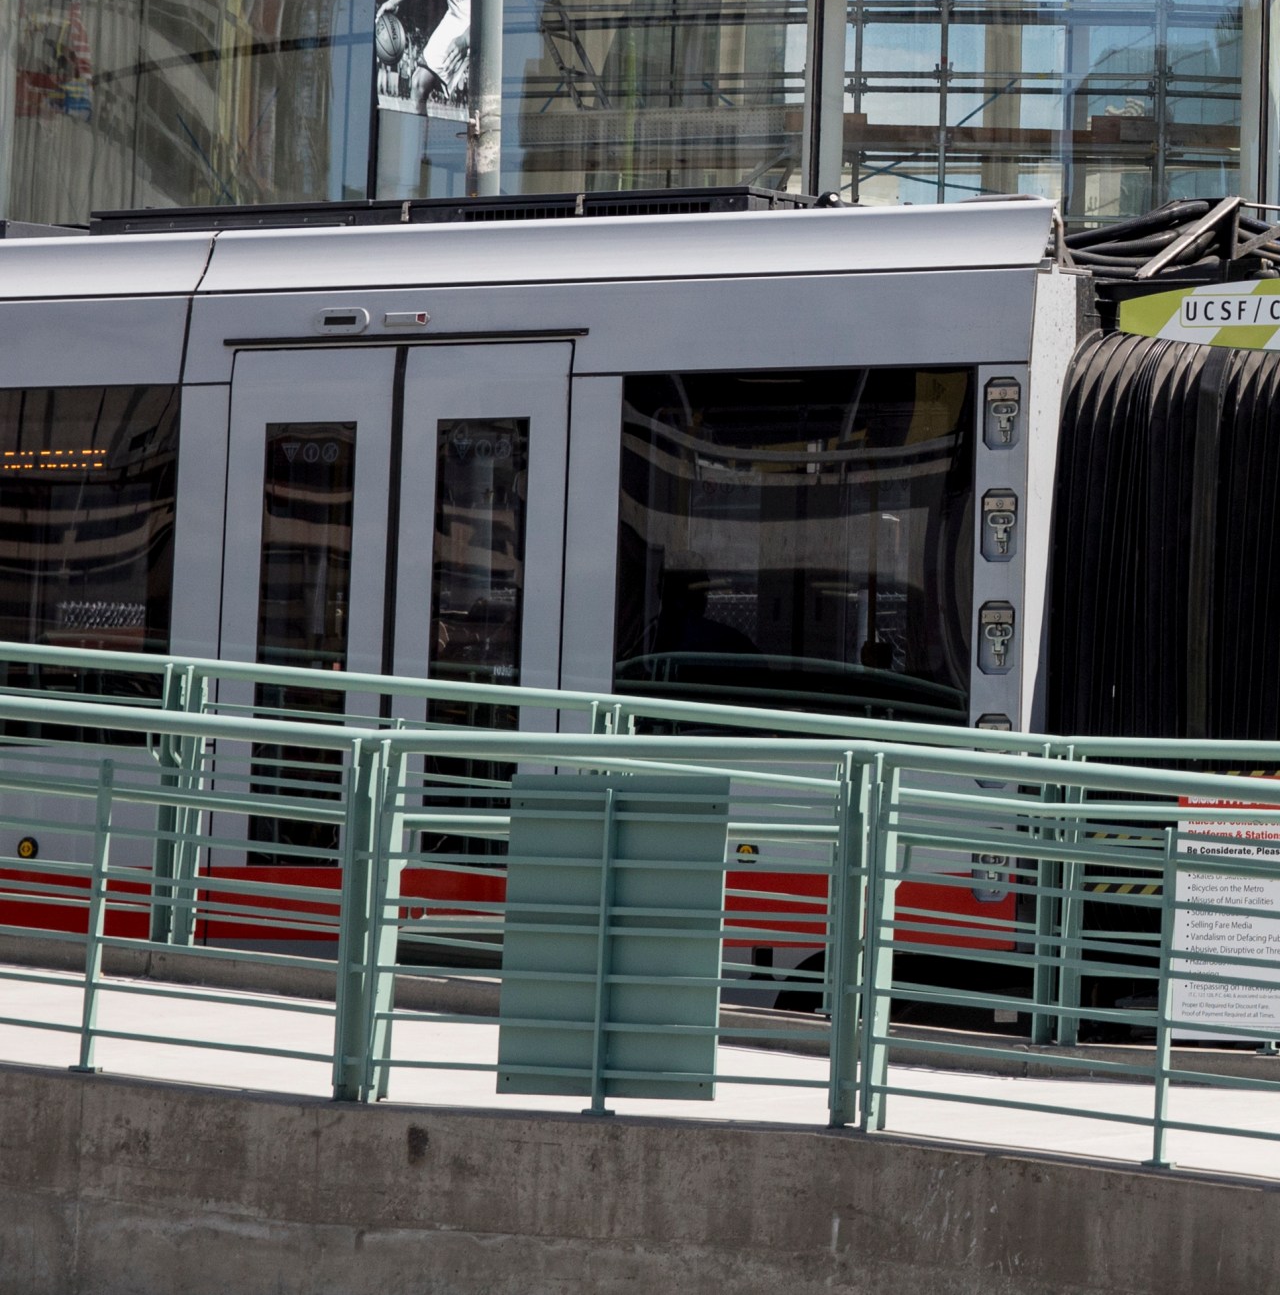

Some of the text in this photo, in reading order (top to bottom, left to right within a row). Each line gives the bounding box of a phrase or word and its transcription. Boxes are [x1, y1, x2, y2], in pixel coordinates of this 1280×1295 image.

[1187, 846, 1197, 854] Be
[1200, 847, 1254, 856] Considerate,
[1192, 884, 1218, 893] Bicycles
[1230, 884, 1242, 892] the
[1243, 885, 1265, 893] Metro
[1191, 896, 1215, 904] Misuse
[1216, 896, 1224, 904] of
[1245, 897, 1274, 905] Facilities
[1191, 921, 1213, 930] Selling
[1232, 921, 1253, 929] Media
[1191, 933, 1226, 941] Vandalism
[1236, 933, 1267, 944] Defacing
[1220, 946, 1255, 955] Disruptive
[1189, 982, 1228, 992] Trespassing
[1224, 1011, 1246, 1019] Required
